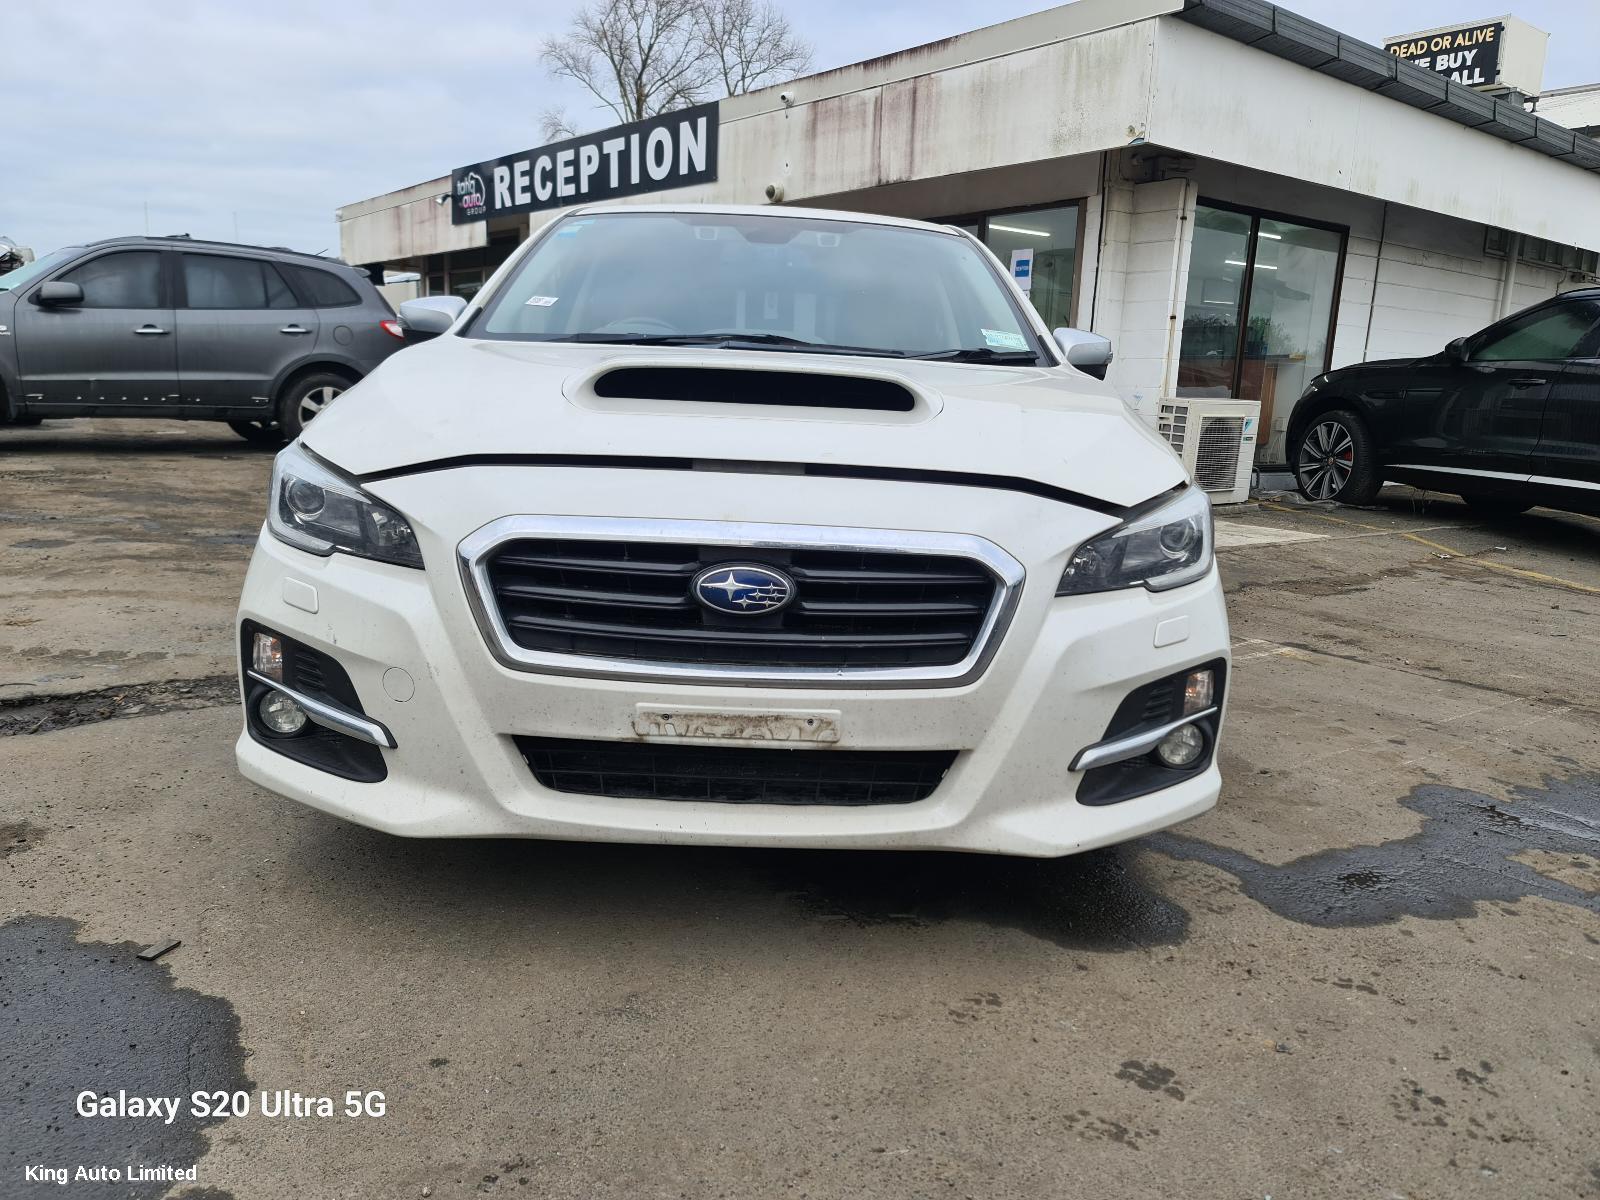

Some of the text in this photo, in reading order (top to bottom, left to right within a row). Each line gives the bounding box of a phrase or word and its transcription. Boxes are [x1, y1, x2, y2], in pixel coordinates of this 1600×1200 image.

[1390, 26, 1495, 58] DEAD OR ALIVE
[1435, 48, 1479, 72] BUY
[1450, 67, 1485, 86] ALL
[493, 116, 707, 210] RECEPTION
